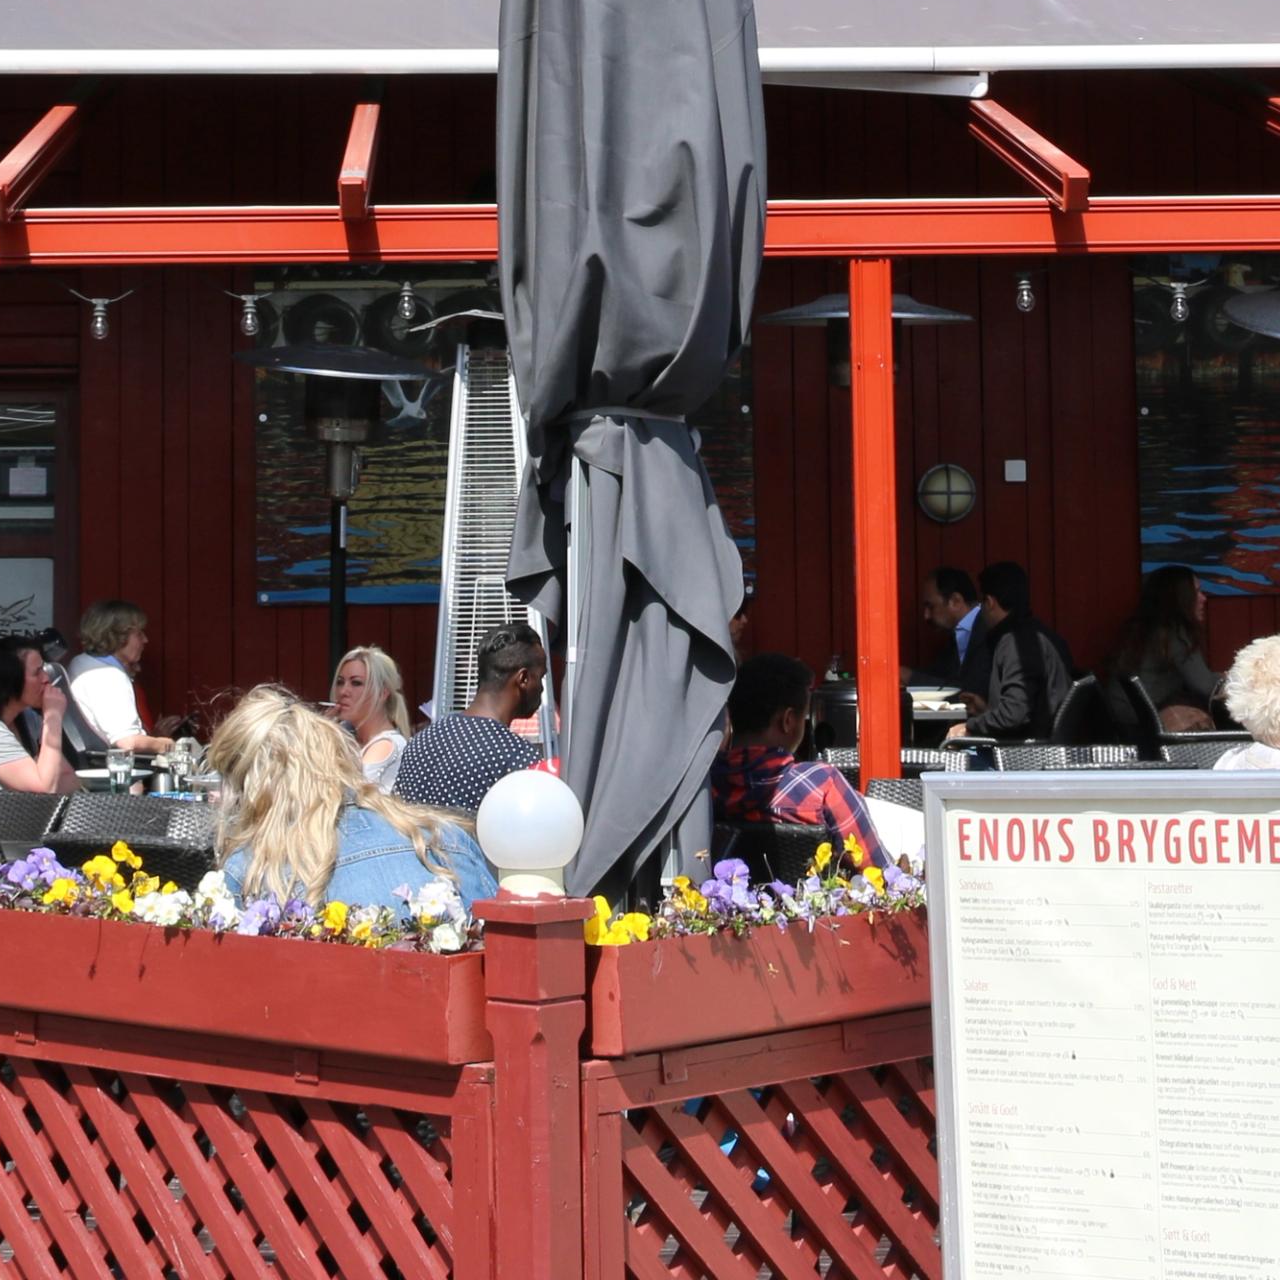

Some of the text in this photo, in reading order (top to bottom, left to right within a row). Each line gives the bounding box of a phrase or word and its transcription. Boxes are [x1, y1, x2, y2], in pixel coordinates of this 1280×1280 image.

[957, 818, 1075, 862] ENOKS
[959, 879, 994, 891] Sandwich
[1153, 978, 1168, 990] God
[1178, 979, 1197, 991] Mett
[1163, 1228, 1180, 1241] Søtt
[1191, 1230, 1211, 1243] Godt
